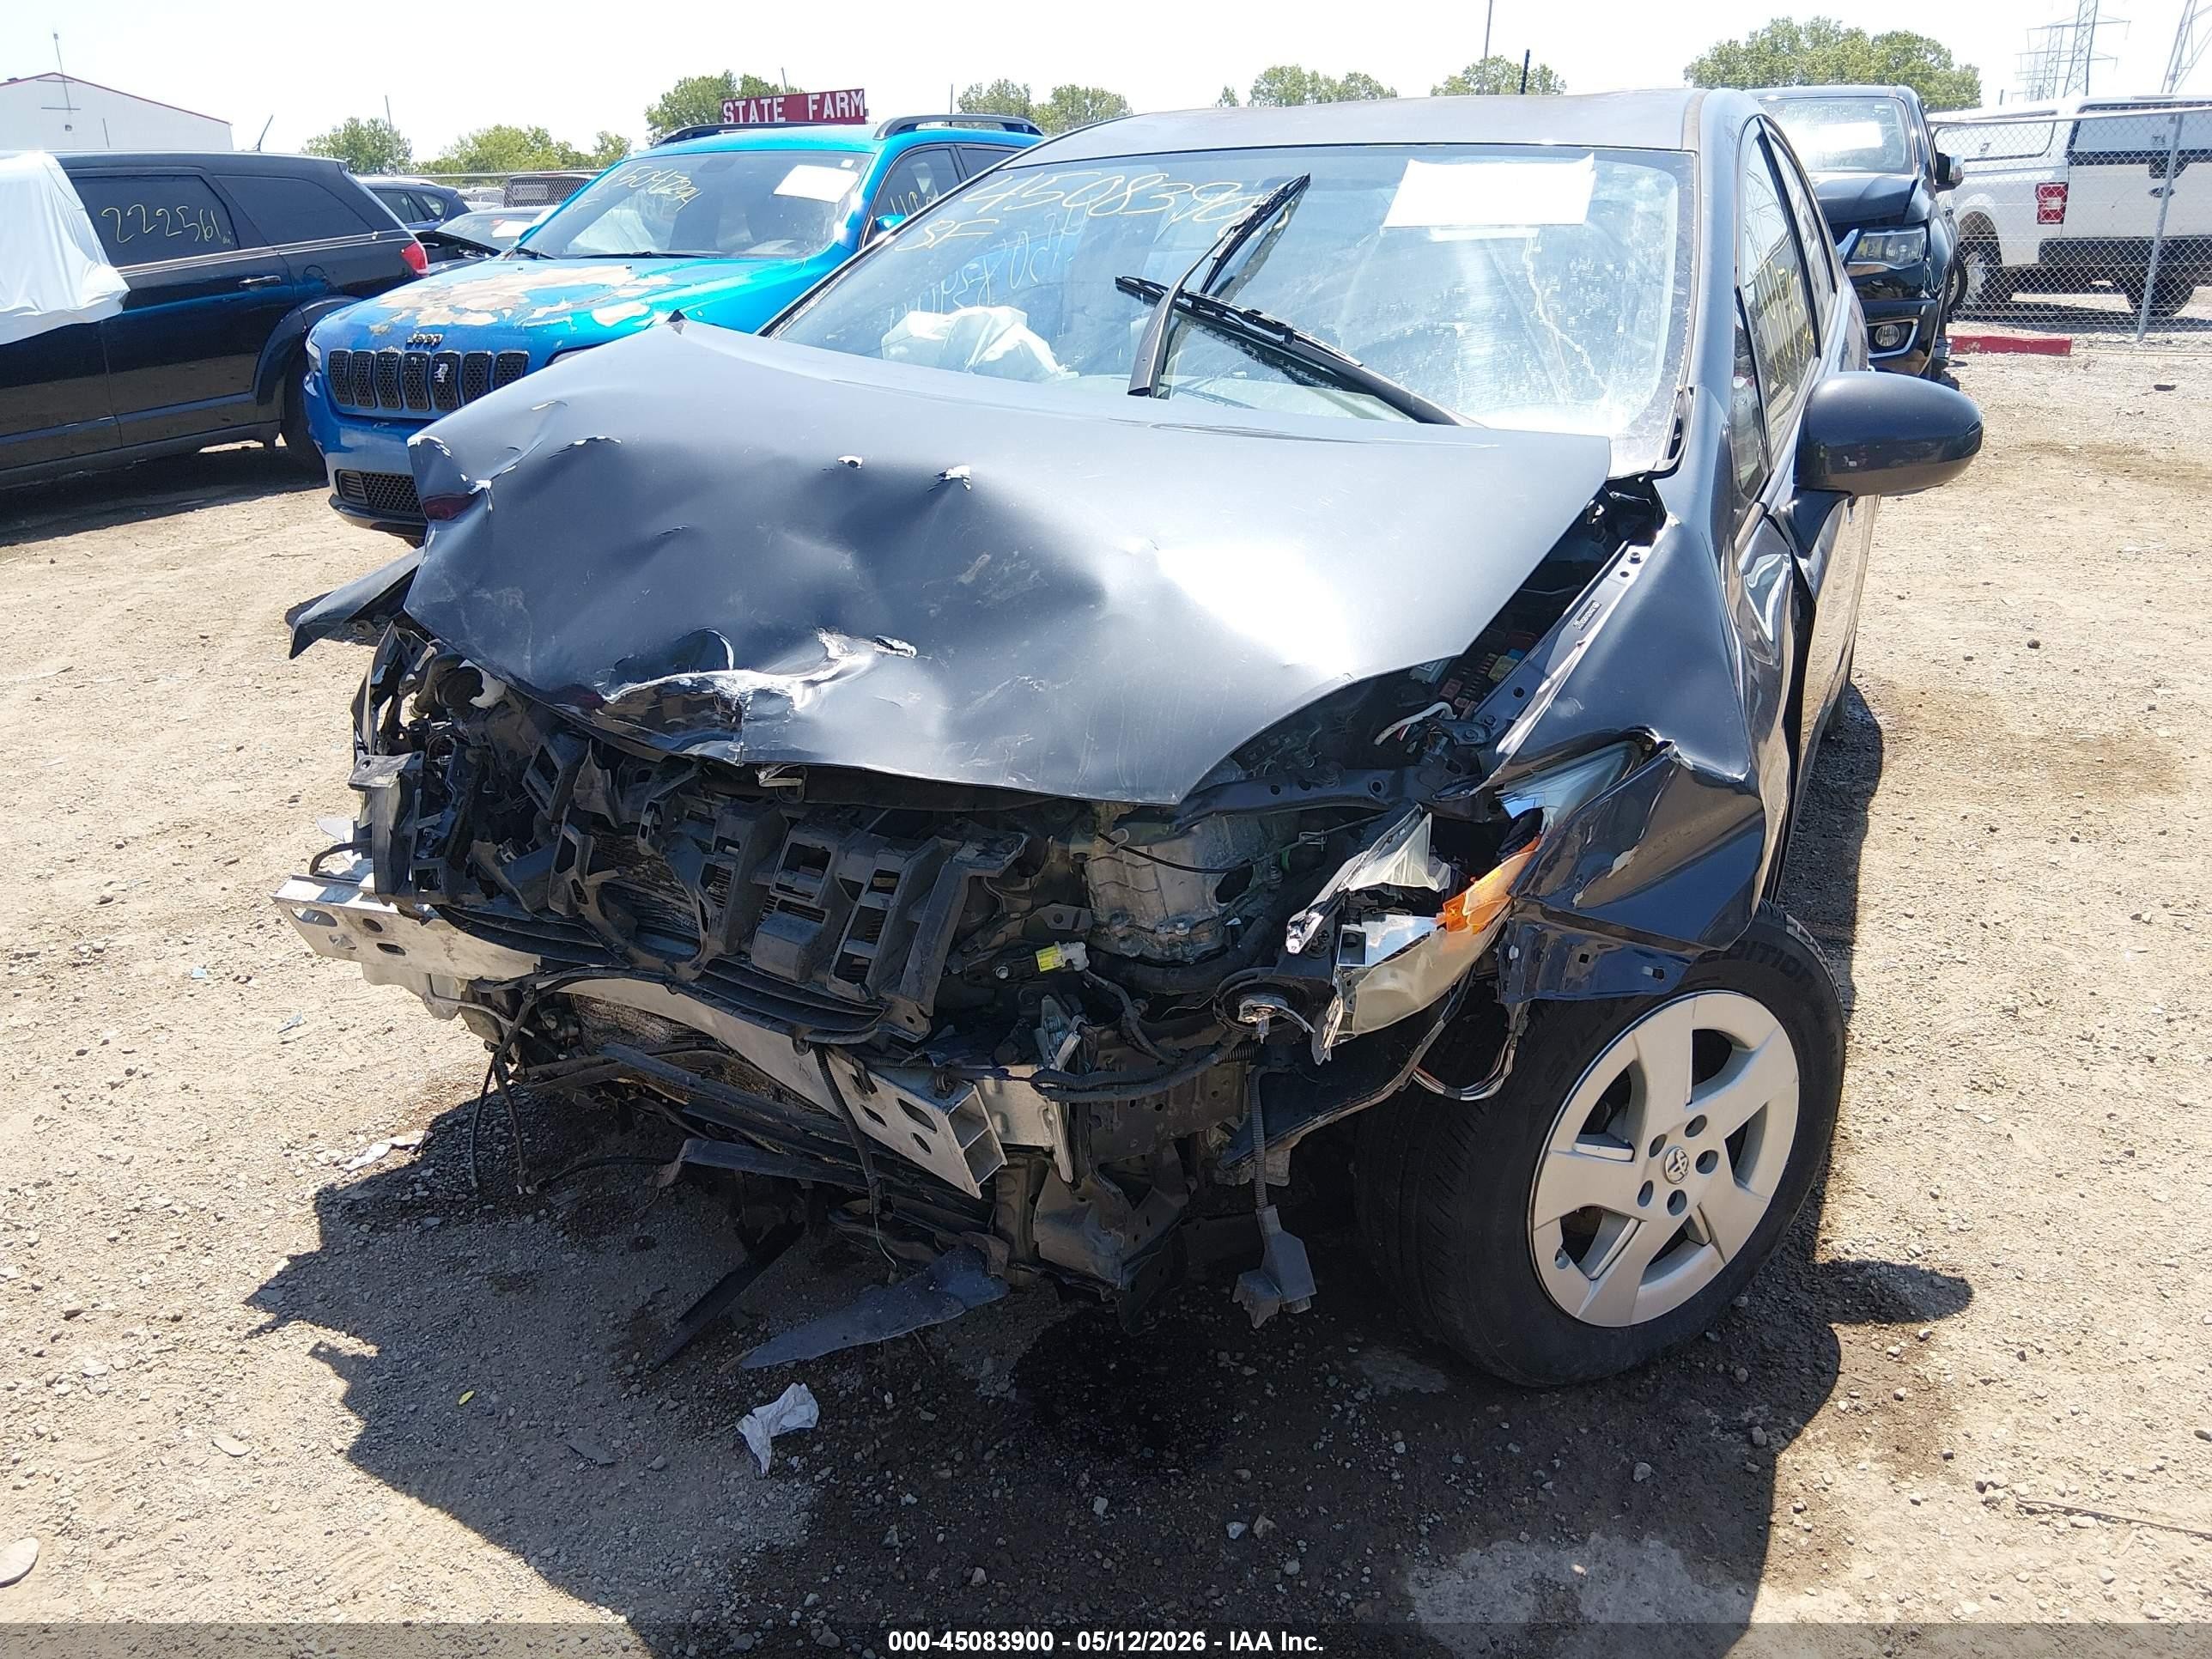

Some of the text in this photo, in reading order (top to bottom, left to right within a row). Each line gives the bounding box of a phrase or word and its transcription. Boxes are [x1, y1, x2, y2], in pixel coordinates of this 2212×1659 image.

[723, 89, 865, 124] STATE FARM
[100, 203, 222, 244] 222561
[894, 218, 1000, 252] SF
